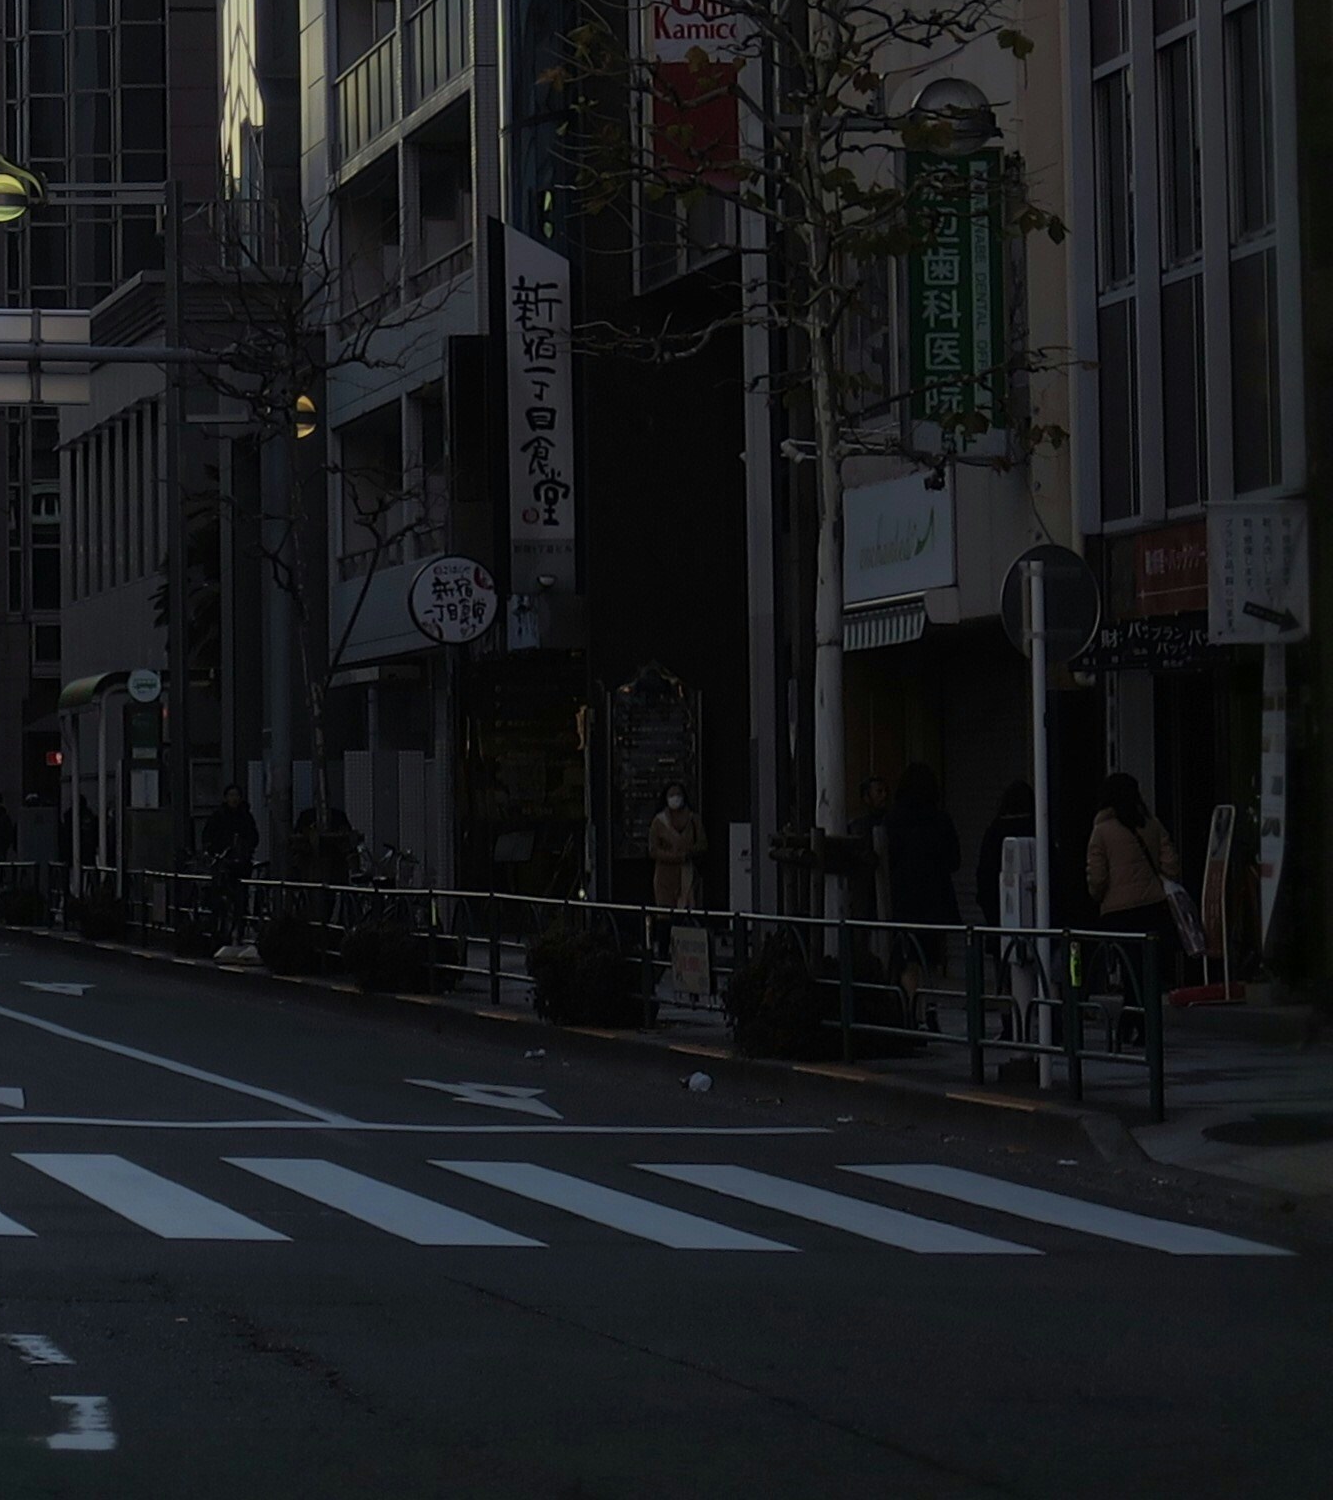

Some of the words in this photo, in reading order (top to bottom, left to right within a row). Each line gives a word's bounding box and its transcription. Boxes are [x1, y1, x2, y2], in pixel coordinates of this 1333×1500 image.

[512, 275, 571, 527] 新宿一丁目食堂
